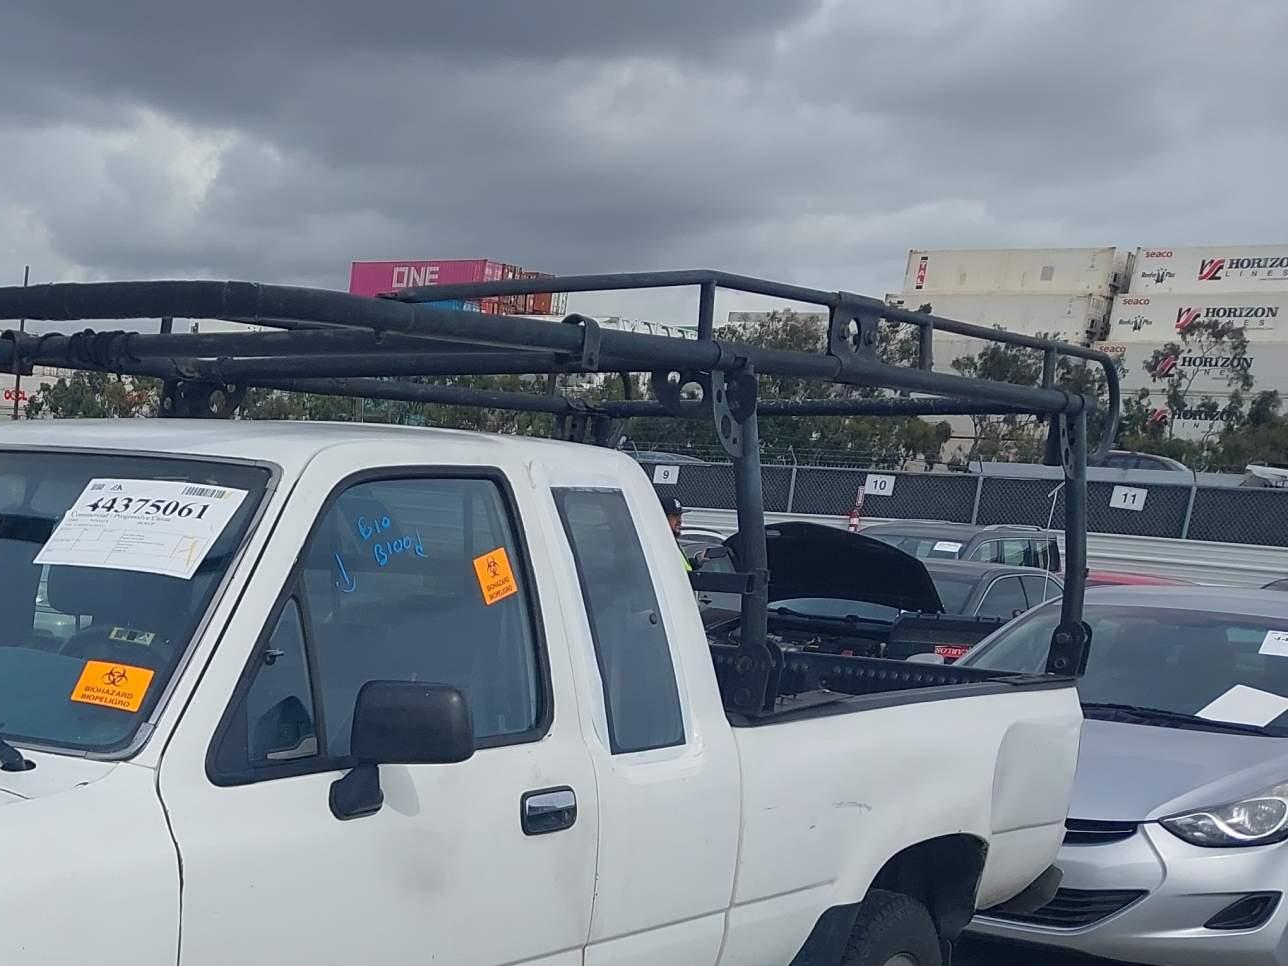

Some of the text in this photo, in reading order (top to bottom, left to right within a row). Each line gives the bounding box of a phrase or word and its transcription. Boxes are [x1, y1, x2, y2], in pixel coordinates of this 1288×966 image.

[1145, 250, 1173, 258] seaco
[391, 266, 440, 288] ONE
[1204, 307, 1280, 318] HORIZON
[1181, 356, 1253, 369] HORIZON
[662, 470, 669, 480] 9
[872, 479, 887, 491] 10
[1121, 493, 1138, 505] 11
[87, 497, 210, 519] 44375061
[84, 686, 134, 700] BIOHAZARD
[81, 693, 130, 708] BIOPELIGRO
